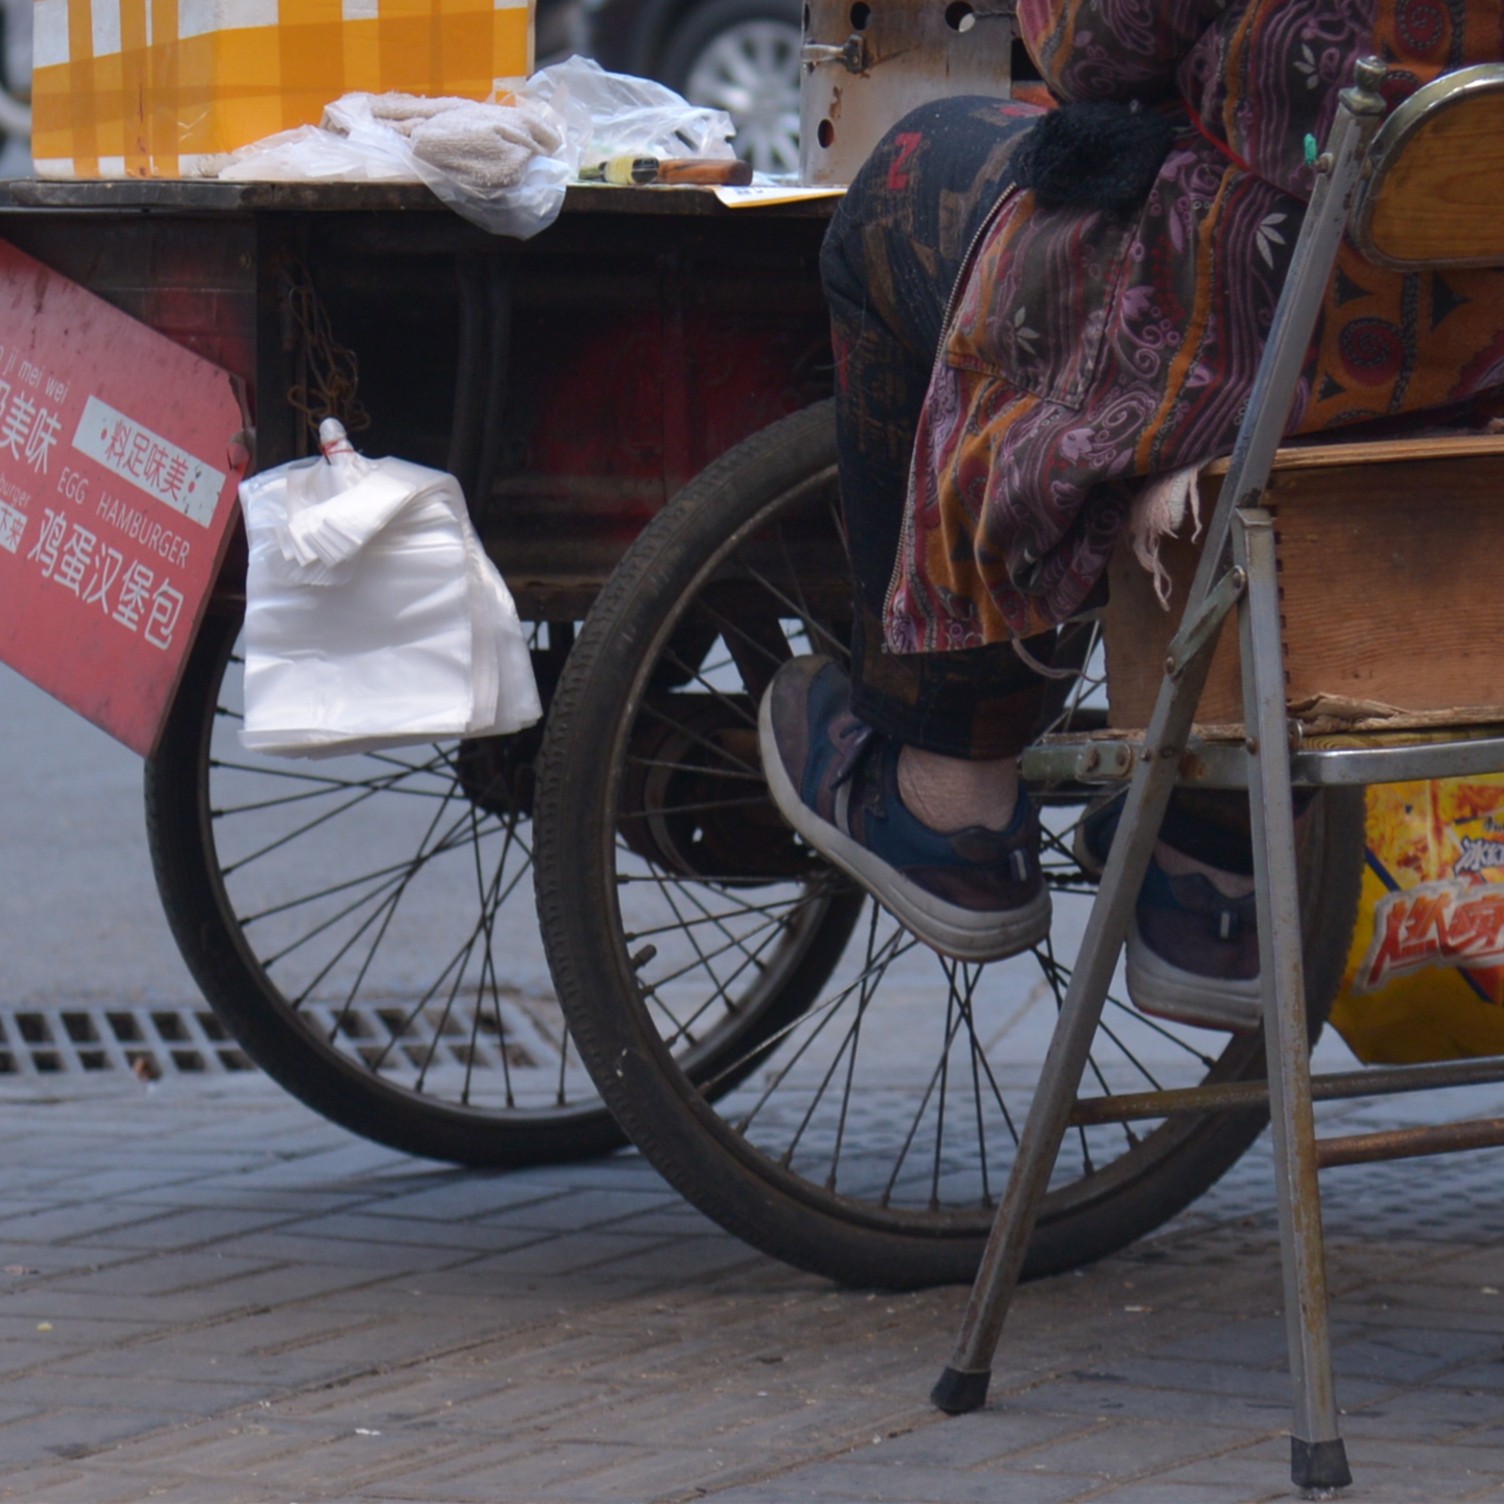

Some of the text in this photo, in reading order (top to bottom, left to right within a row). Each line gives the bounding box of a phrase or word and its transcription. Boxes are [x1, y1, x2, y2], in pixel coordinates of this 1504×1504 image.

[2, 347, 20, 376] ji
[18, 360, 45, 389] mei
[44, 377, 71, 404] wei
[104, 419, 189, 502] 料足味美
[57, 467, 190, 568] EGG HAMBURGER
[27, 507, 184, 650] 鸡蛋汉堡包
